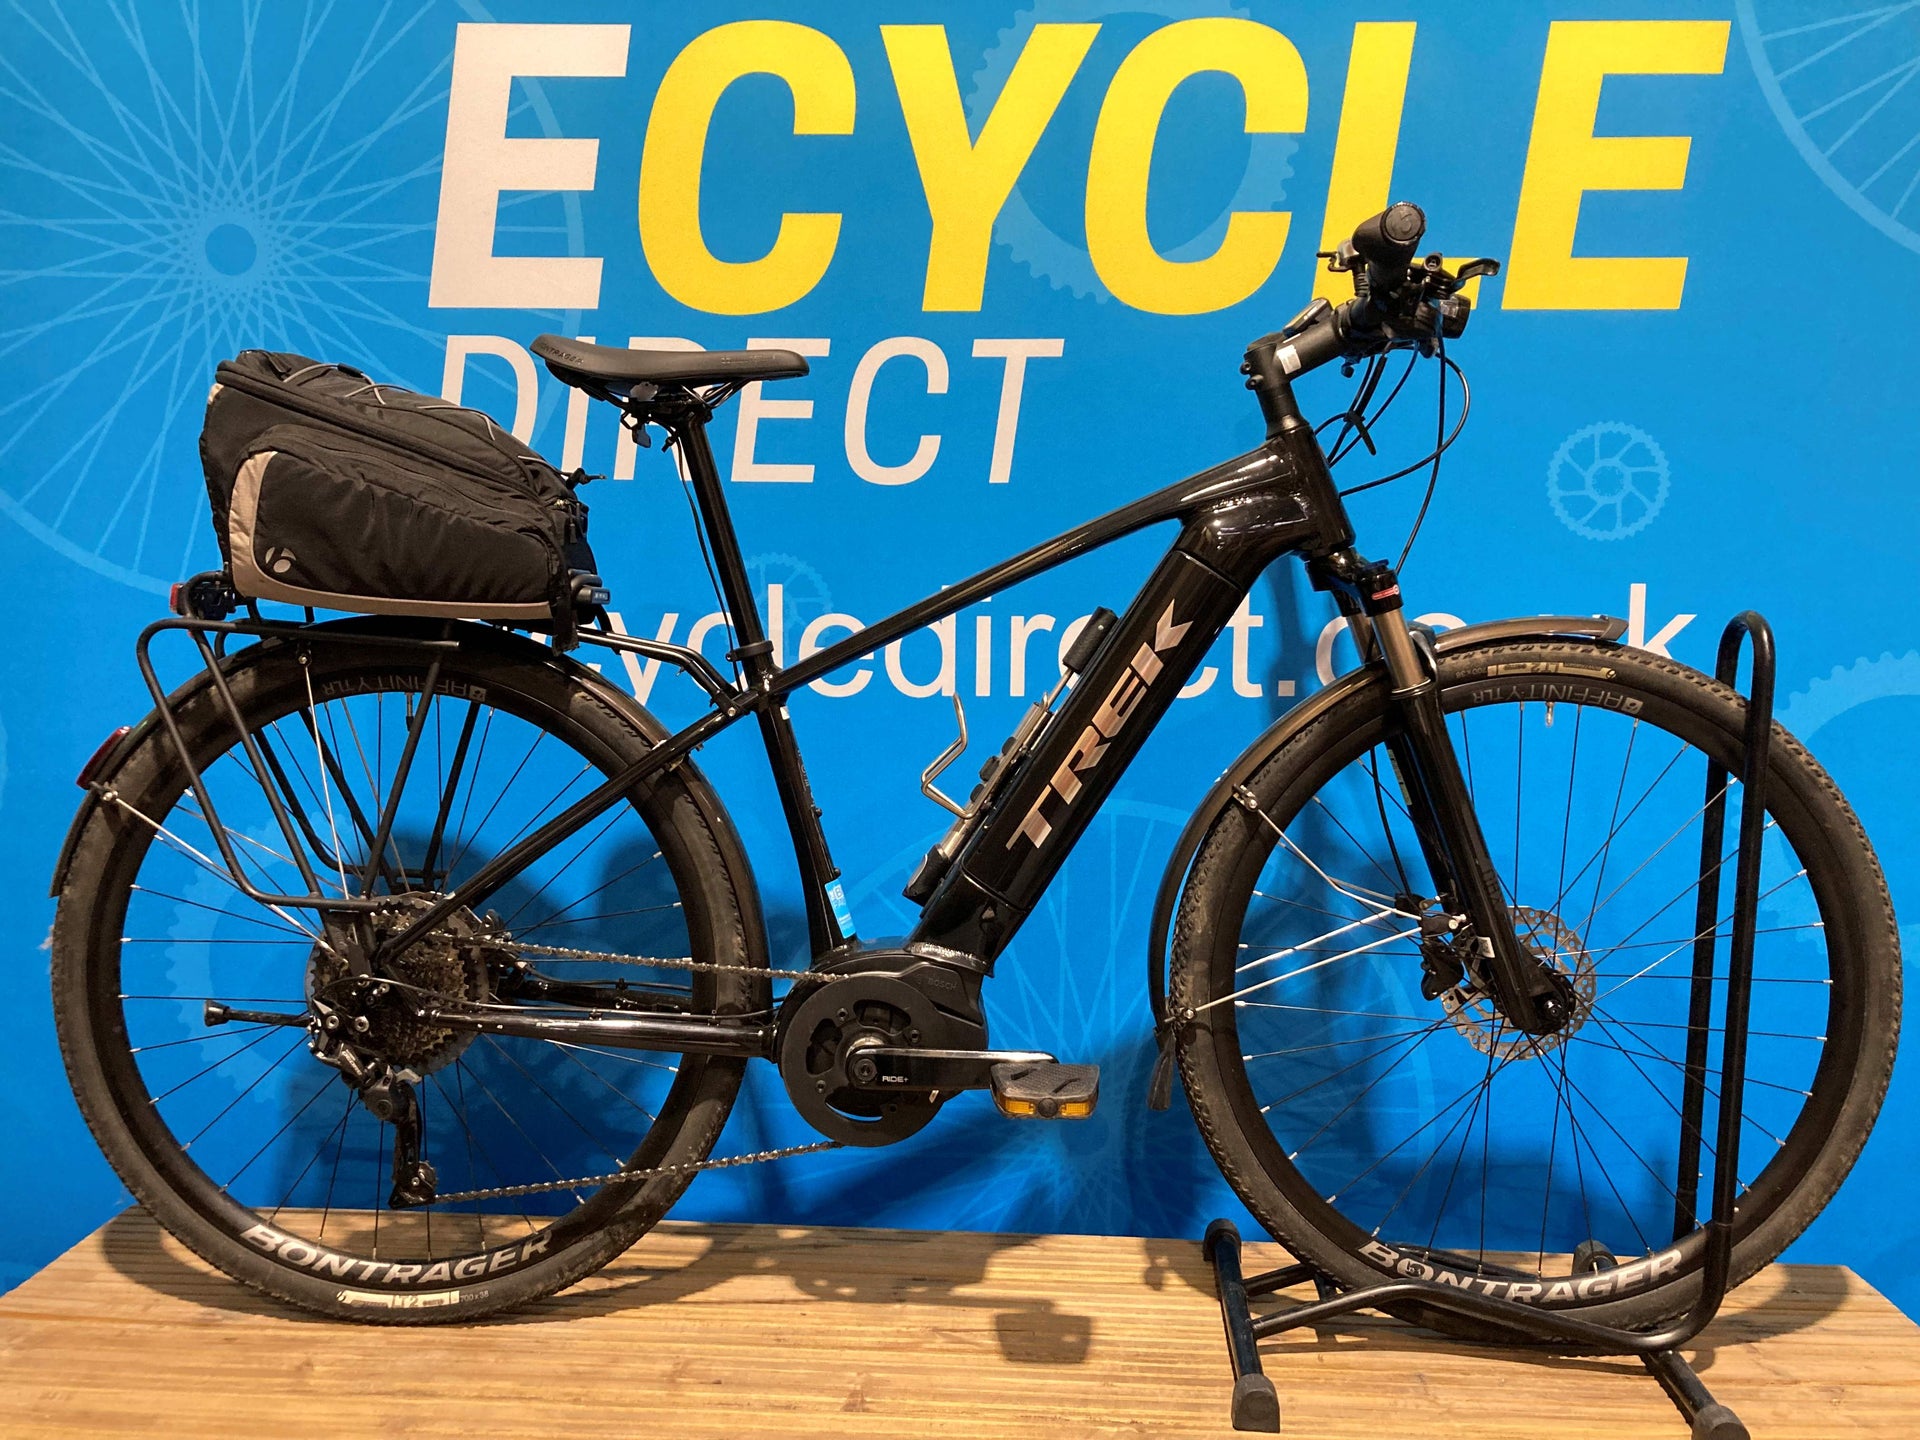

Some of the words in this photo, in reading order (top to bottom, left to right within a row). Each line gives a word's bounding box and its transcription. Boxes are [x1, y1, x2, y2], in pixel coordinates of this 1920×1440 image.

[428, 18, 1731, 315] ECYCLE
[358, 674, 467, 697] AFINITY
[1005, 598, 1194, 850] TREK
[240, 1224, 553, 1284] BONTRAGER
[1358, 1240, 1683, 1303] BONTRAGER
